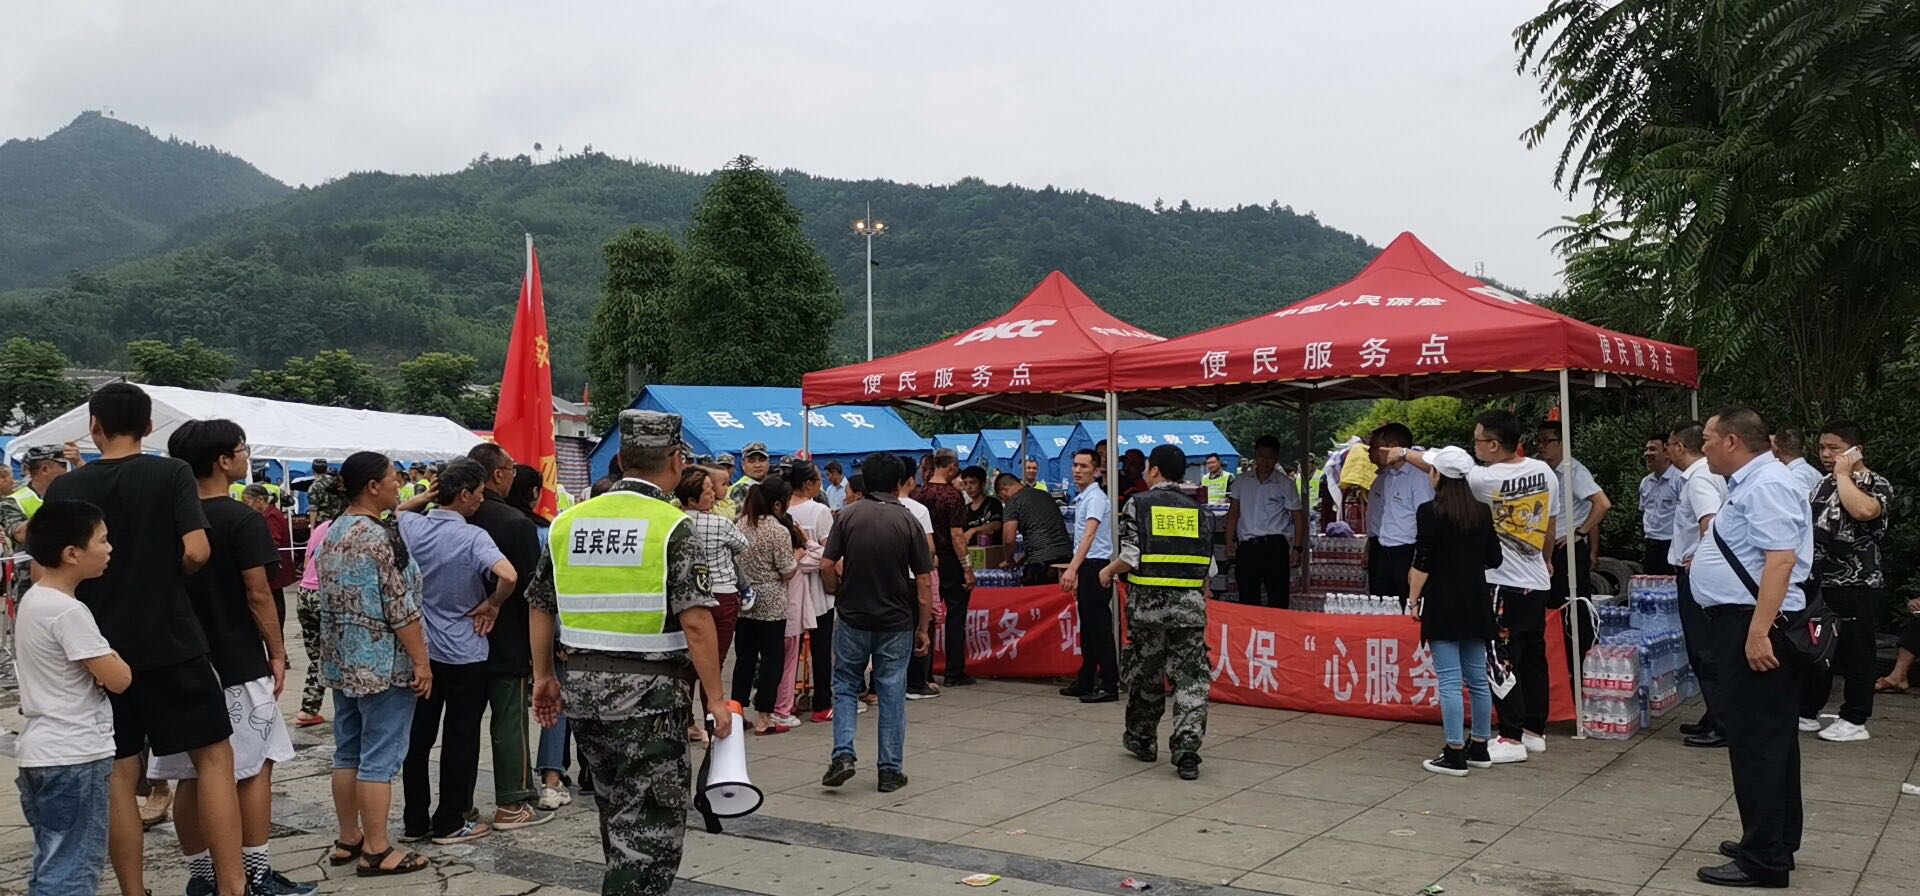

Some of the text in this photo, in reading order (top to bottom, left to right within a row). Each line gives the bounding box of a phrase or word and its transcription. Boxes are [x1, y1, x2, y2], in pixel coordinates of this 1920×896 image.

[1274, 294, 1447, 318] 中国人民保险
[953, 319, 1058, 346] PICC
[1200, 333, 1450, 379] 便民服务点
[1597, 333, 1676, 375] 便民服务点
[862, 362, 1033, 396] 便民服务点
[707, 410, 875, 429] 民政救灾
[1154, 513, 1196, 532] 宜宾民兵
[572, 528, 639, 555] 宜宾民兵
